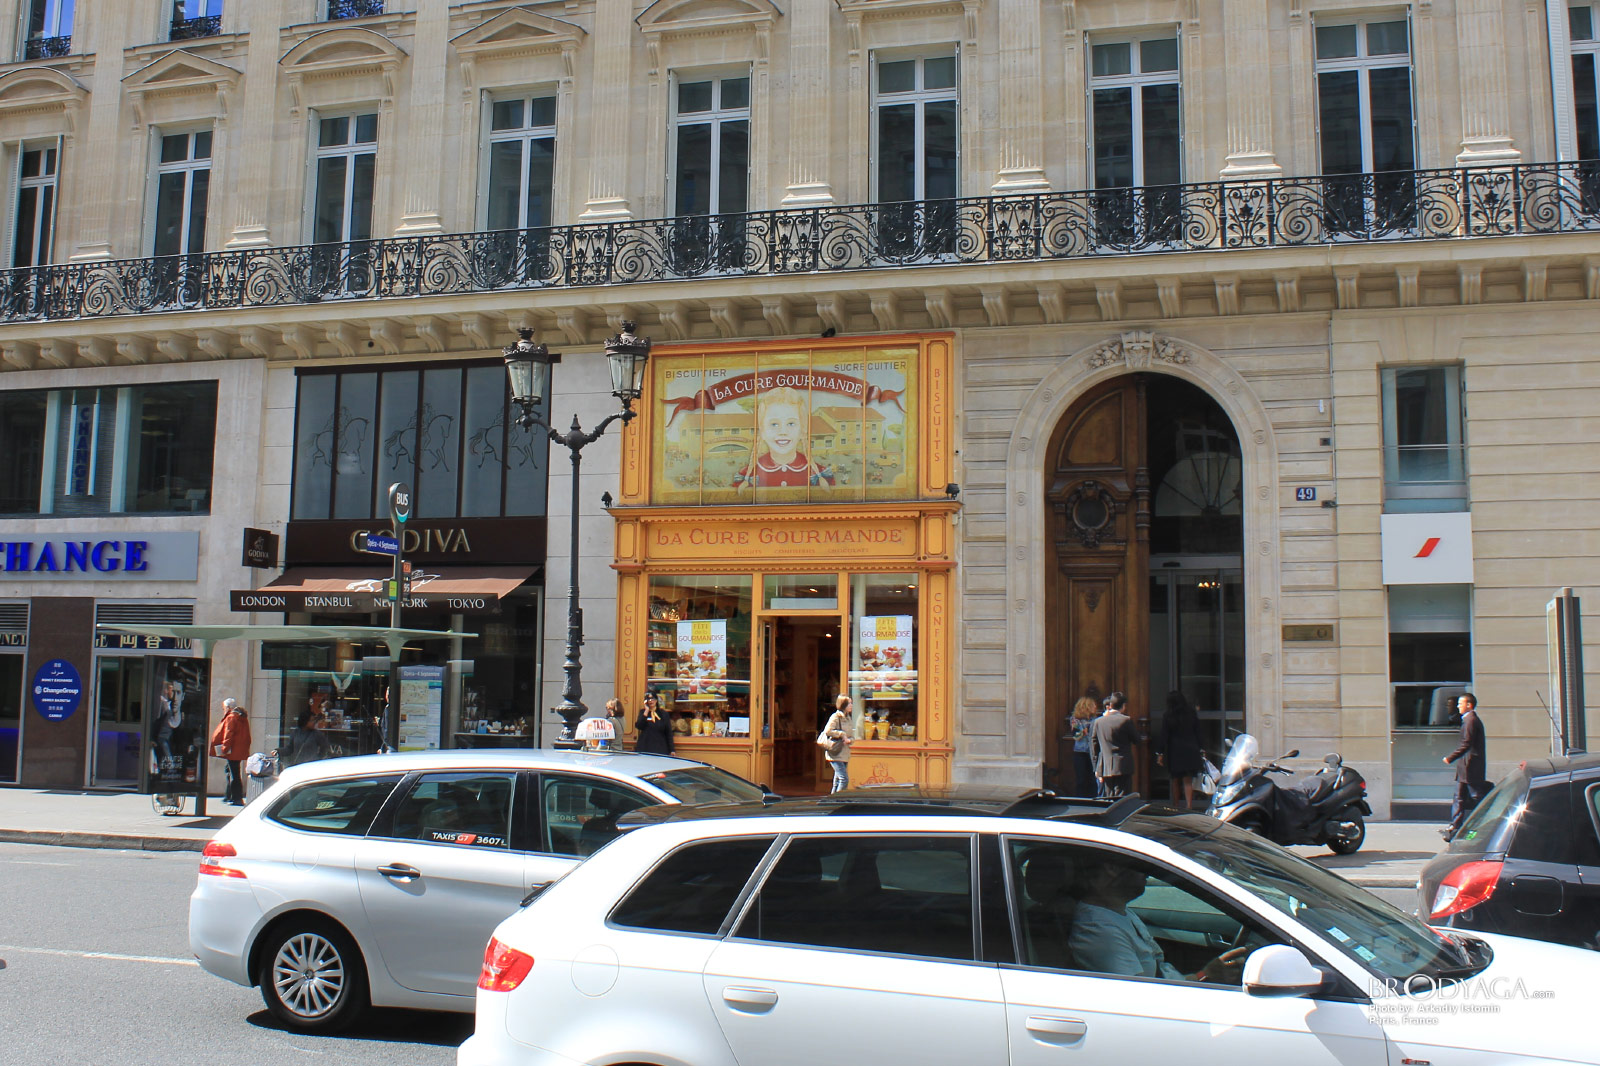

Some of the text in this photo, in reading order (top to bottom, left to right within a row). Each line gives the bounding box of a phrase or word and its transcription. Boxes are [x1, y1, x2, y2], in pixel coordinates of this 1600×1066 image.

[665, 368, 727, 379] BISCUITIER
[714, 373, 863, 401] LA CURE GOURMANDE
[933, 368, 941, 462] BISCUITS
[629, 398, 637, 470] SUITS
[396, 492, 409, 506] BUS
[1297, 488, 1313, 500] 49
[349, 528, 471, 553] GDIVA
[656, 527, 903, 546] LA CURE GOURMANDE
[0, 540, 149, 573] HANGE
[240, 596, 286, 607] LONDON
[304, 597, 353, 608] ISTANBUL
[448, 598, 485, 609] TOKYO
[678, 634, 725, 642] GOURMANDISE
[861, 630, 911, 638] GOURMANDISE
[624, 604, 633, 704] CHOCOLATS
[933, 593, 942, 722] CONFISERIES
[43, 687, 79, 695] ChangeGroup
[592, 719, 606, 730] TAXI
[432, 832, 456, 841] TAXIS
[457, 833, 469, 842] G7
[476, 836, 501, 846] 3607
